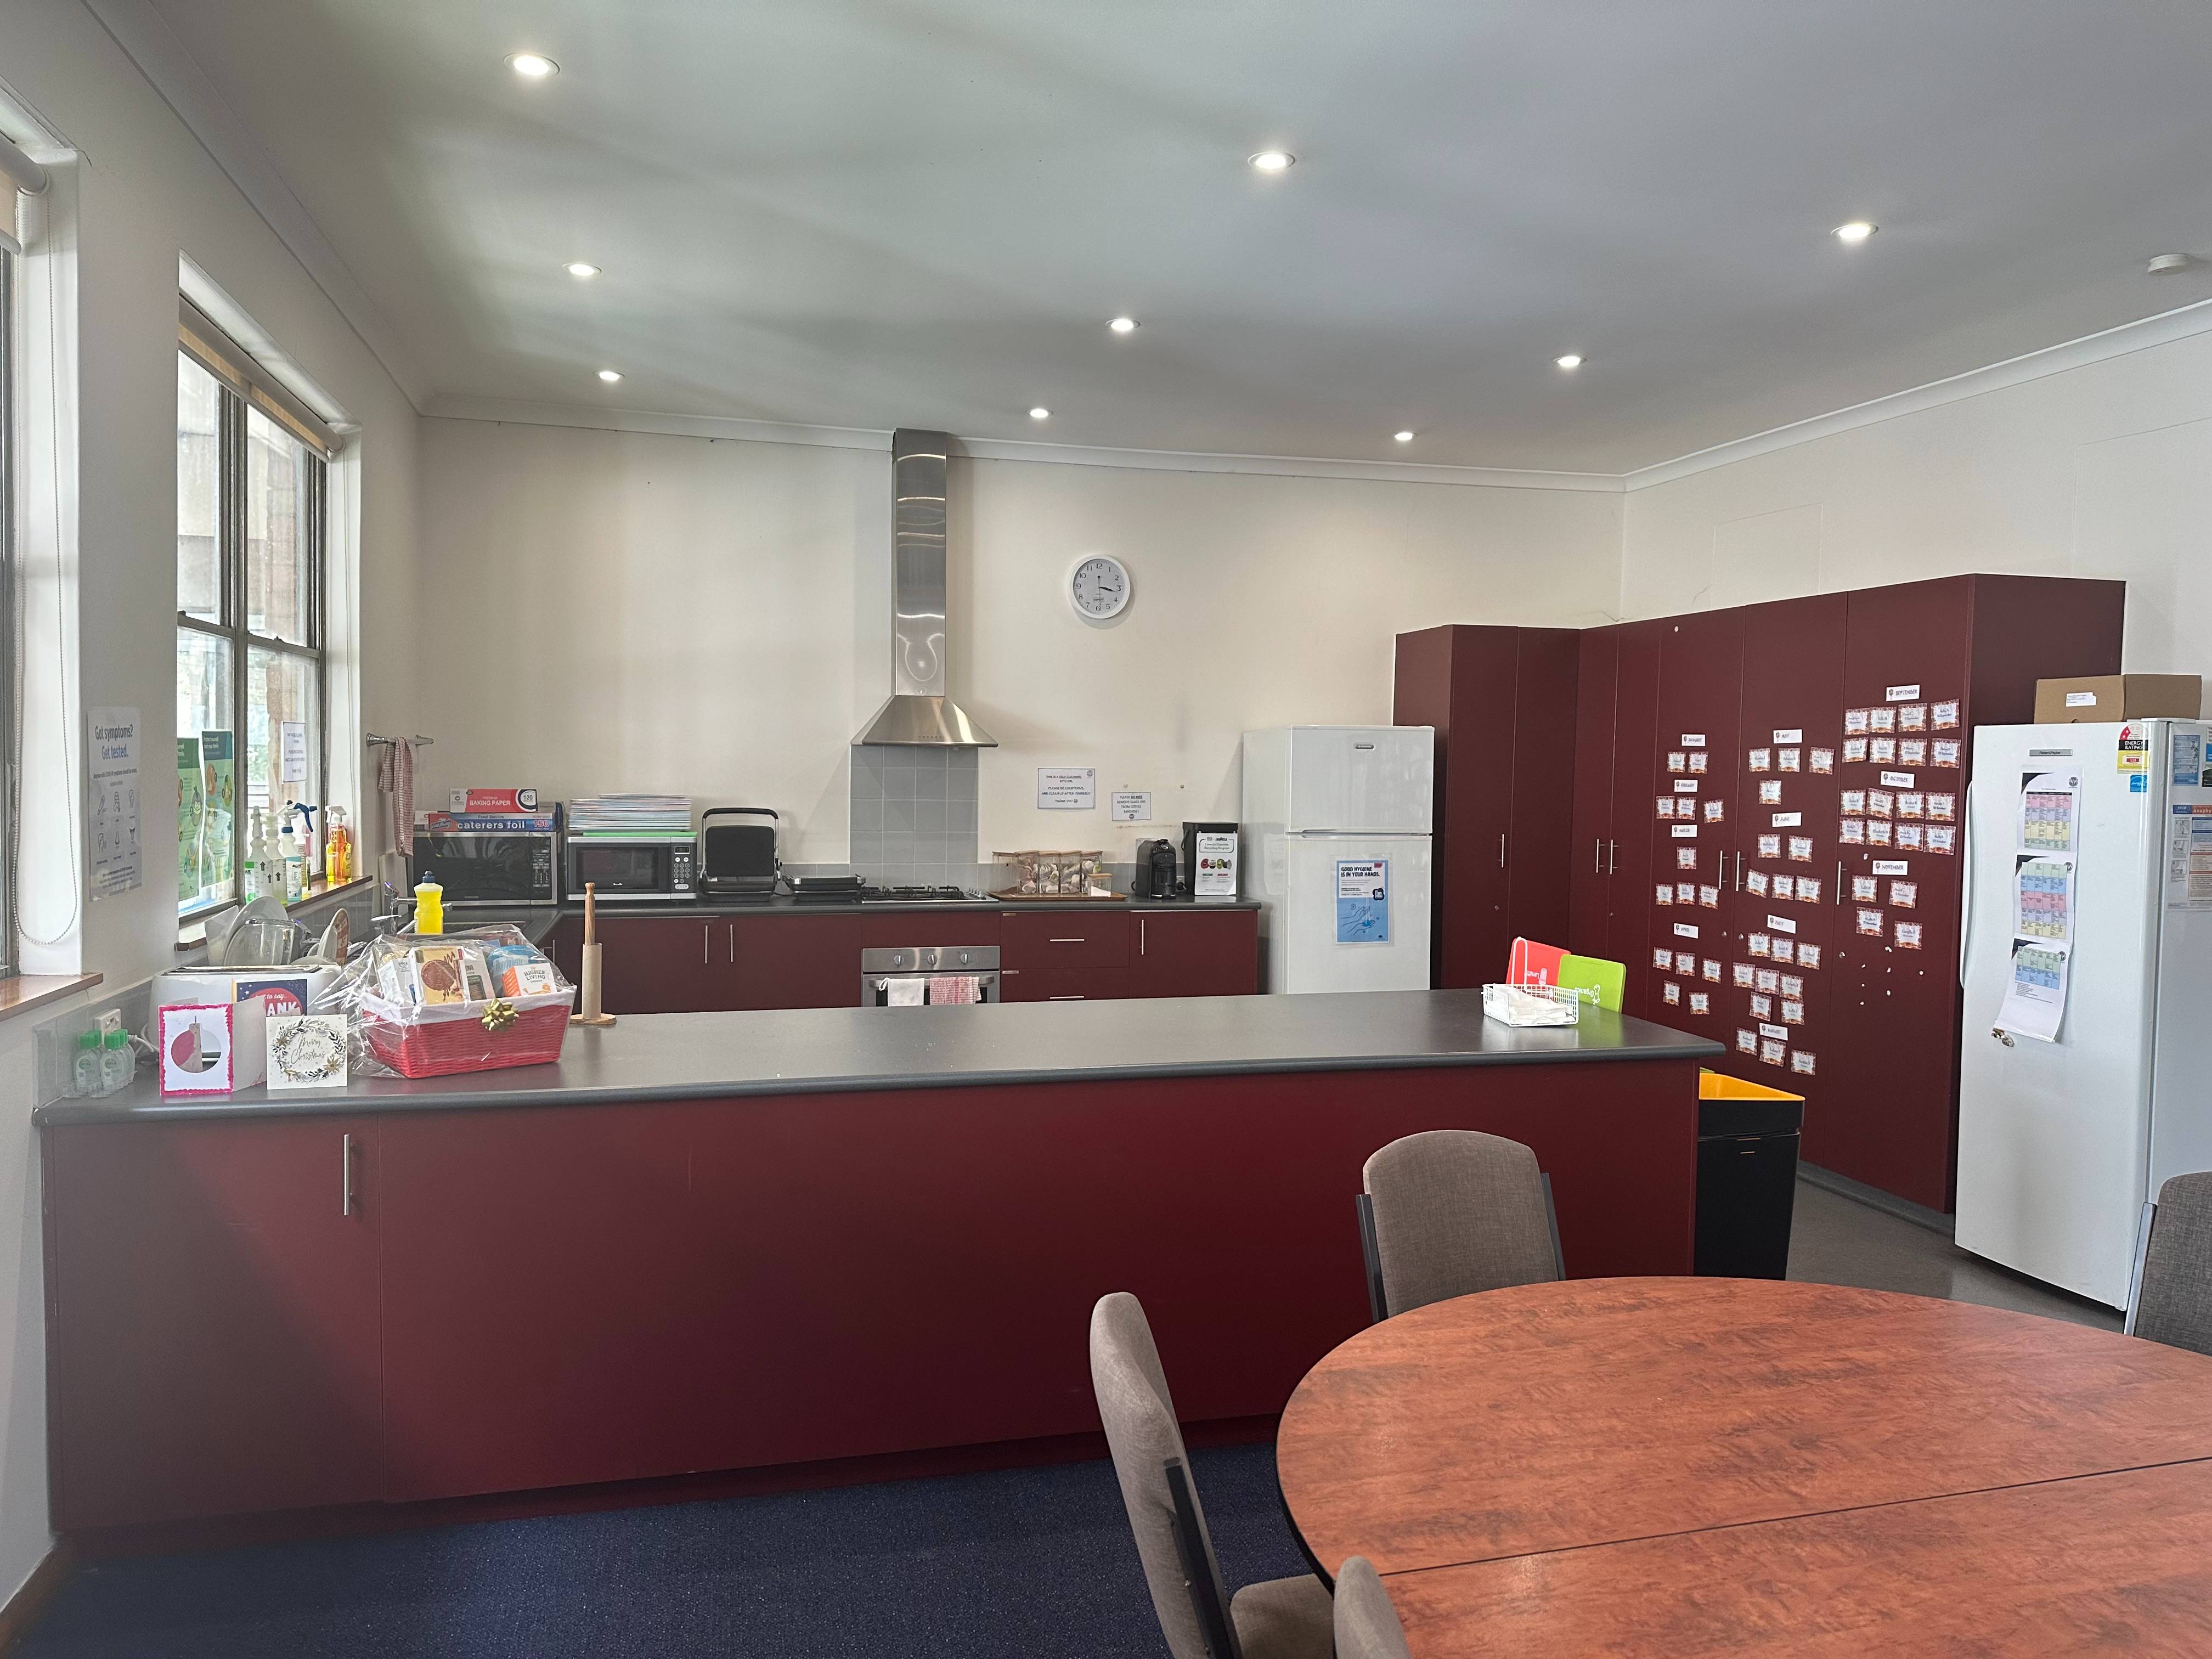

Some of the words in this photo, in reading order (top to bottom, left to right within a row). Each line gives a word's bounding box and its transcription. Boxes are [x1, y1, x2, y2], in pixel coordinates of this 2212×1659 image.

[95, 725, 104, 740] Got
[104, 724, 133, 742] symptoms?
[101, 746, 111, 760] Get
[111, 743, 129, 759] tested.
[507, 821, 525, 829] foil
[267, 1001, 297, 1016] ANK
[298, 1034, 320, 1050] Merry
[291, 1048, 326, 1064] Christmas
